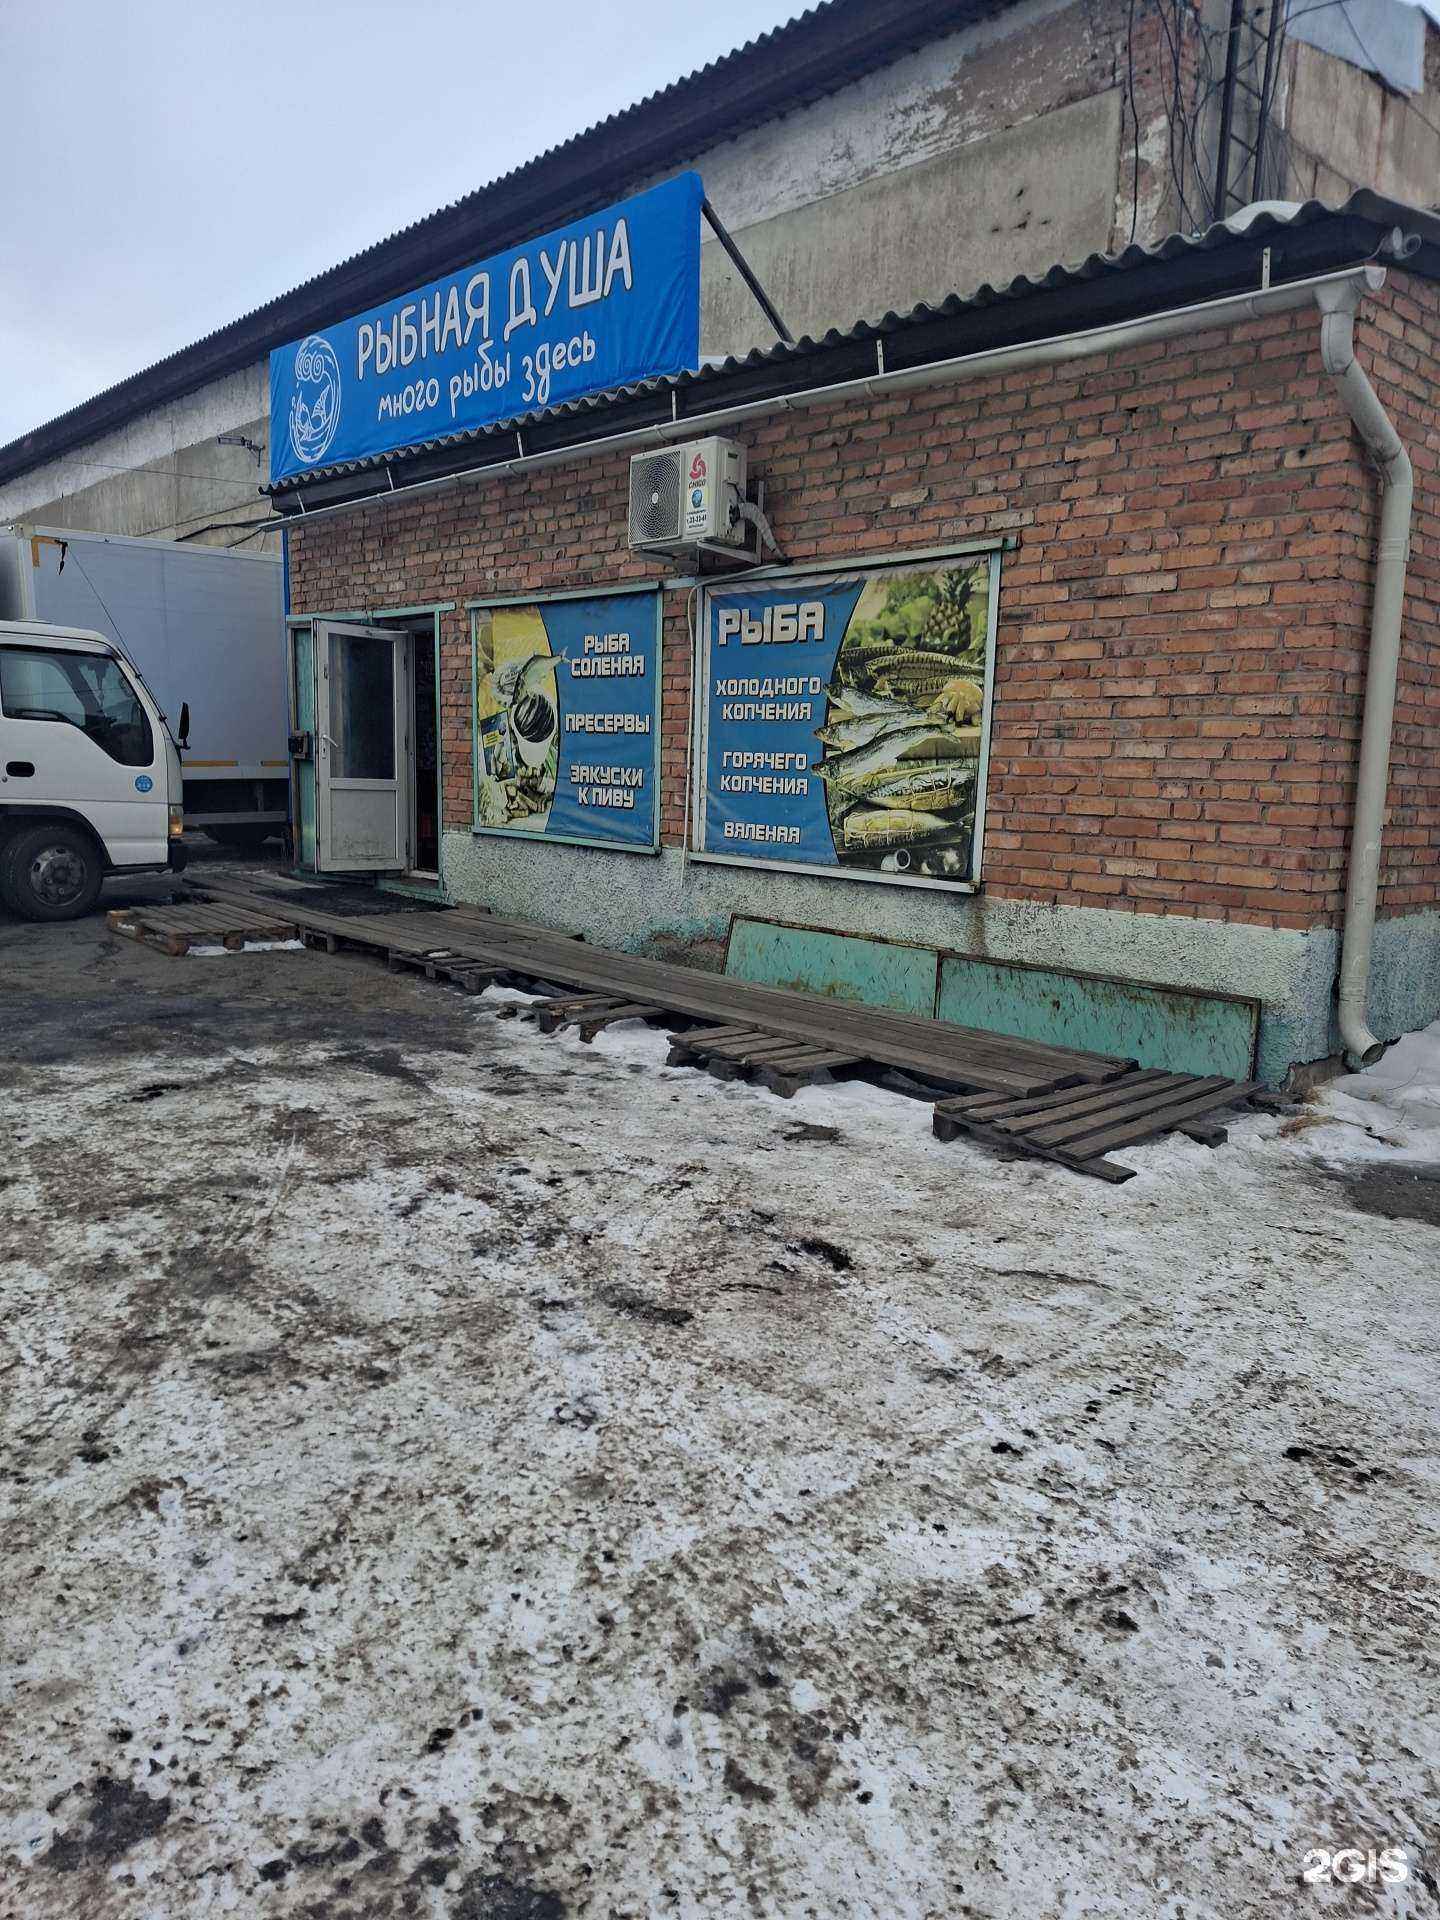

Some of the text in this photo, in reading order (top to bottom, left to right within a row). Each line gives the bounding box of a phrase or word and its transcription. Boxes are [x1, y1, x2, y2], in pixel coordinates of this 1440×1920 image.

[357, 219, 632, 380] РЫБНАЯ ДУША
[377, 329, 597, 422] много рыбы здесь
[718, 602, 825, 645] РЫБА
[584, 633, 630, 654] РЫБА
[570, 656, 644, 677] СОЛЕНАЯ
[716, 677, 821, 697] ХОЛОДНОГО
[722, 702, 812, 721] КОПЧЕНИЯ
[566, 713, 649, 733] ПРЕСЕРВЫ
[722, 751, 808, 771] ГОРЯЧЕГО
[570, 766, 643, 786] ЗАКУСКИ
[719, 776, 809, 796] КОПЧЕНИЯ
[578, 787, 635, 809] К ПИВУ
[723, 820, 801, 844] ВЯЛЕНАЯ
